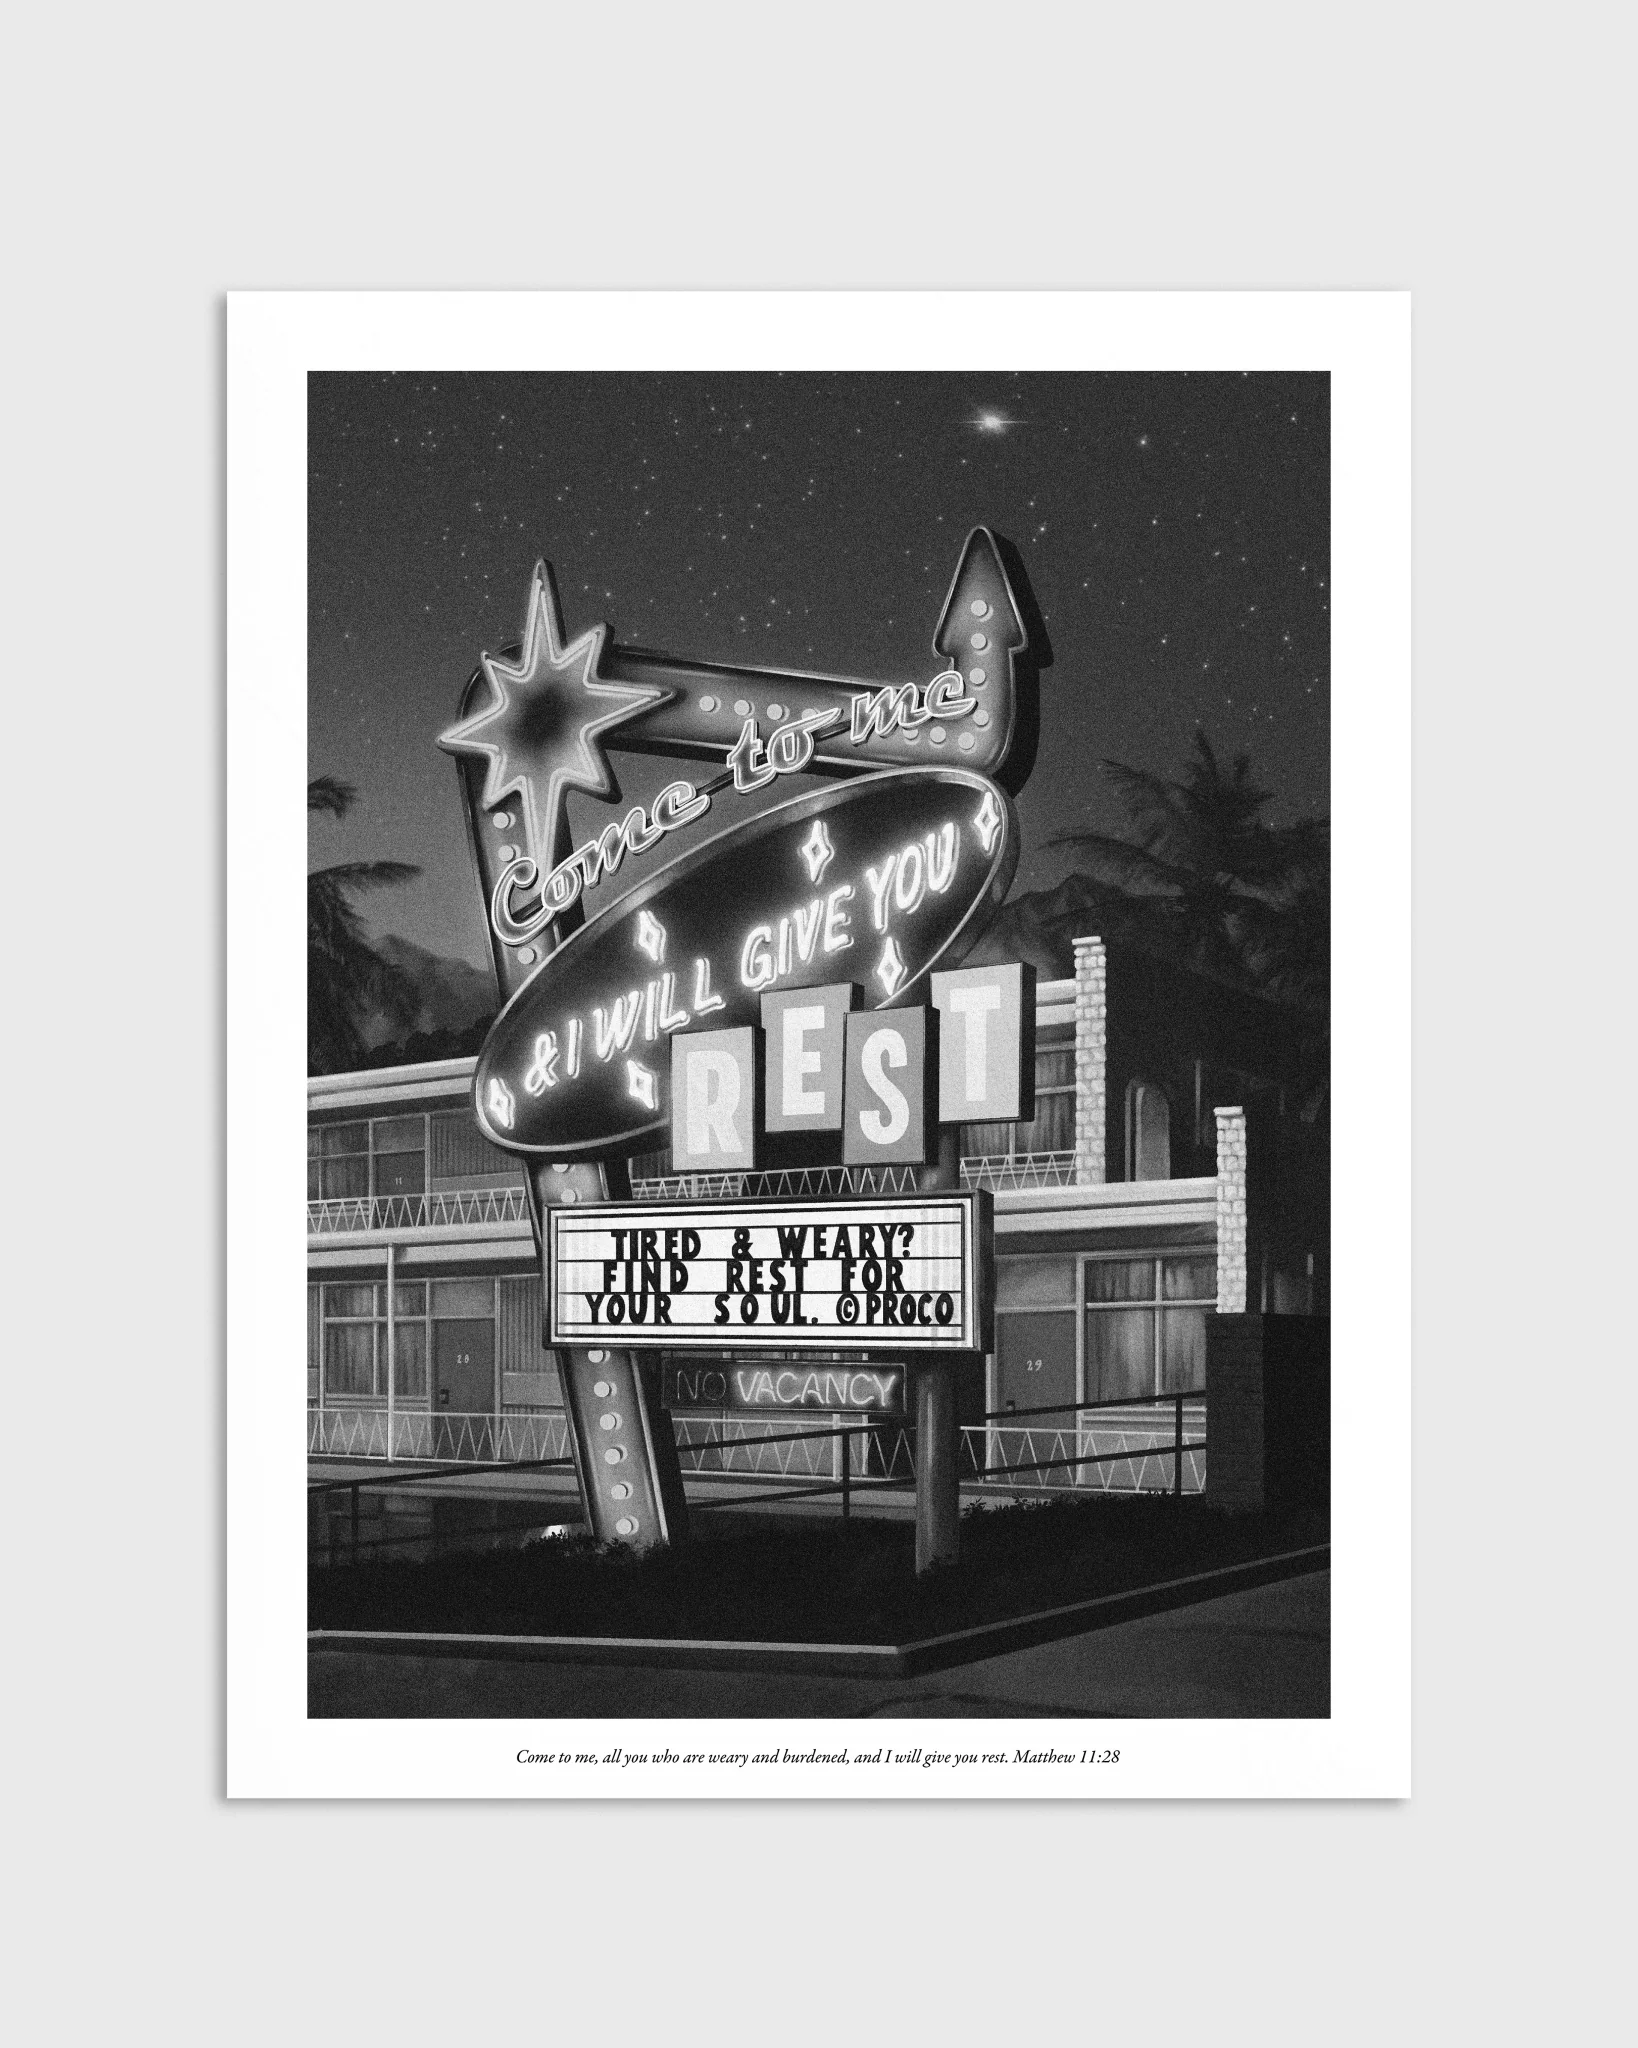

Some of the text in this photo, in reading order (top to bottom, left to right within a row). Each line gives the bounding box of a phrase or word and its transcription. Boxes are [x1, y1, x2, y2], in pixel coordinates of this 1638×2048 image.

[492, 670, 978, 946] Come to me
[523, 821, 961, 1096] & I WILL GIVE YOU
[685, 984, 1003, 1156] REST
[610, 1223, 915, 1261] TIRED & WEARY?
[602, 1258, 905, 1294] FIND REST FOR
[586, 1293, 673, 1325] YOUR
[1026, 1359, 1043, 1372] 29
[677, 1370, 897, 1407] NO VACANCY
[516, 1748, 1121, 1769] Come to me, all you who are weary and burdened, and I will give you rest. Matthew 11:28
